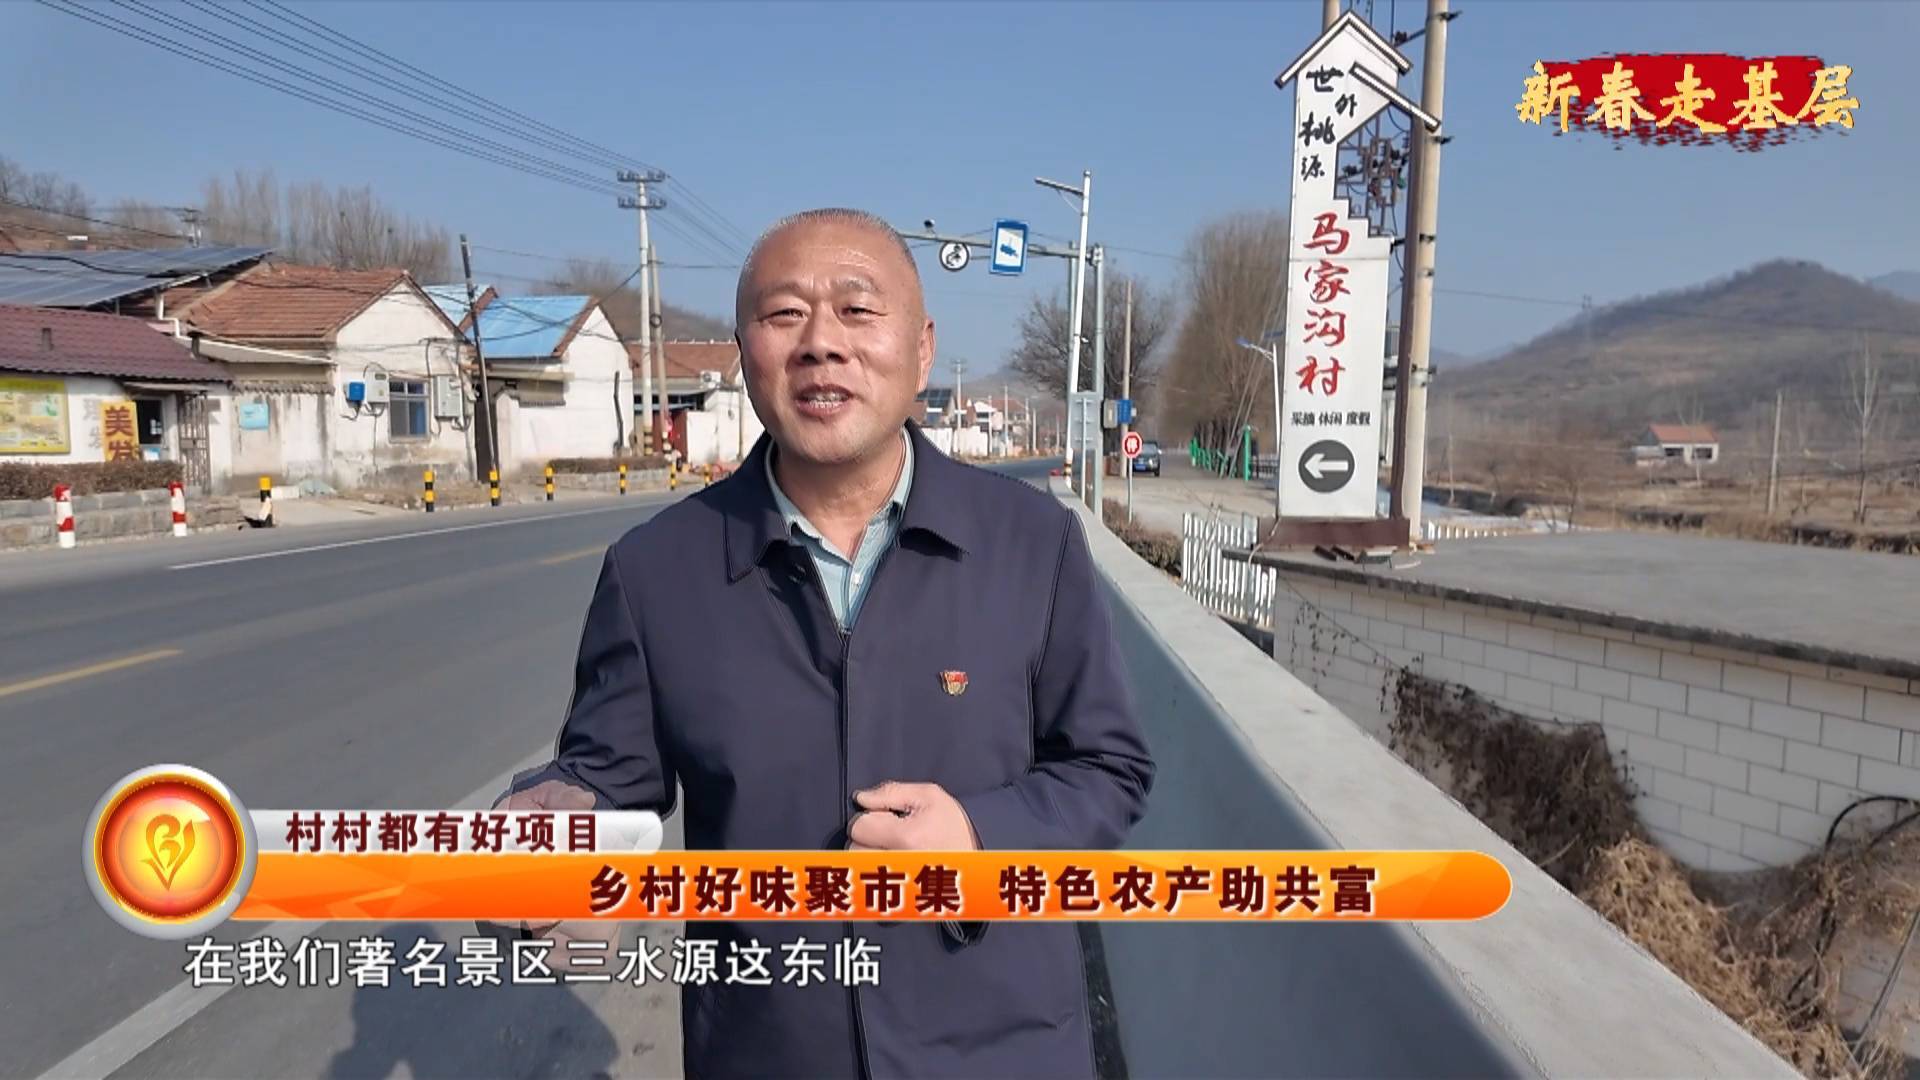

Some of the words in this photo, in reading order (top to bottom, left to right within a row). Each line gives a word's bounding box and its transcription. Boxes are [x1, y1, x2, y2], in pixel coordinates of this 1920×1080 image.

[1298, 65, 1358, 181] 世外桃源
[1296, 212, 1350, 396] 马家沟村
[1319, 411, 1342, 426] 休闲
[1346, 411, 1370, 426] 度假
